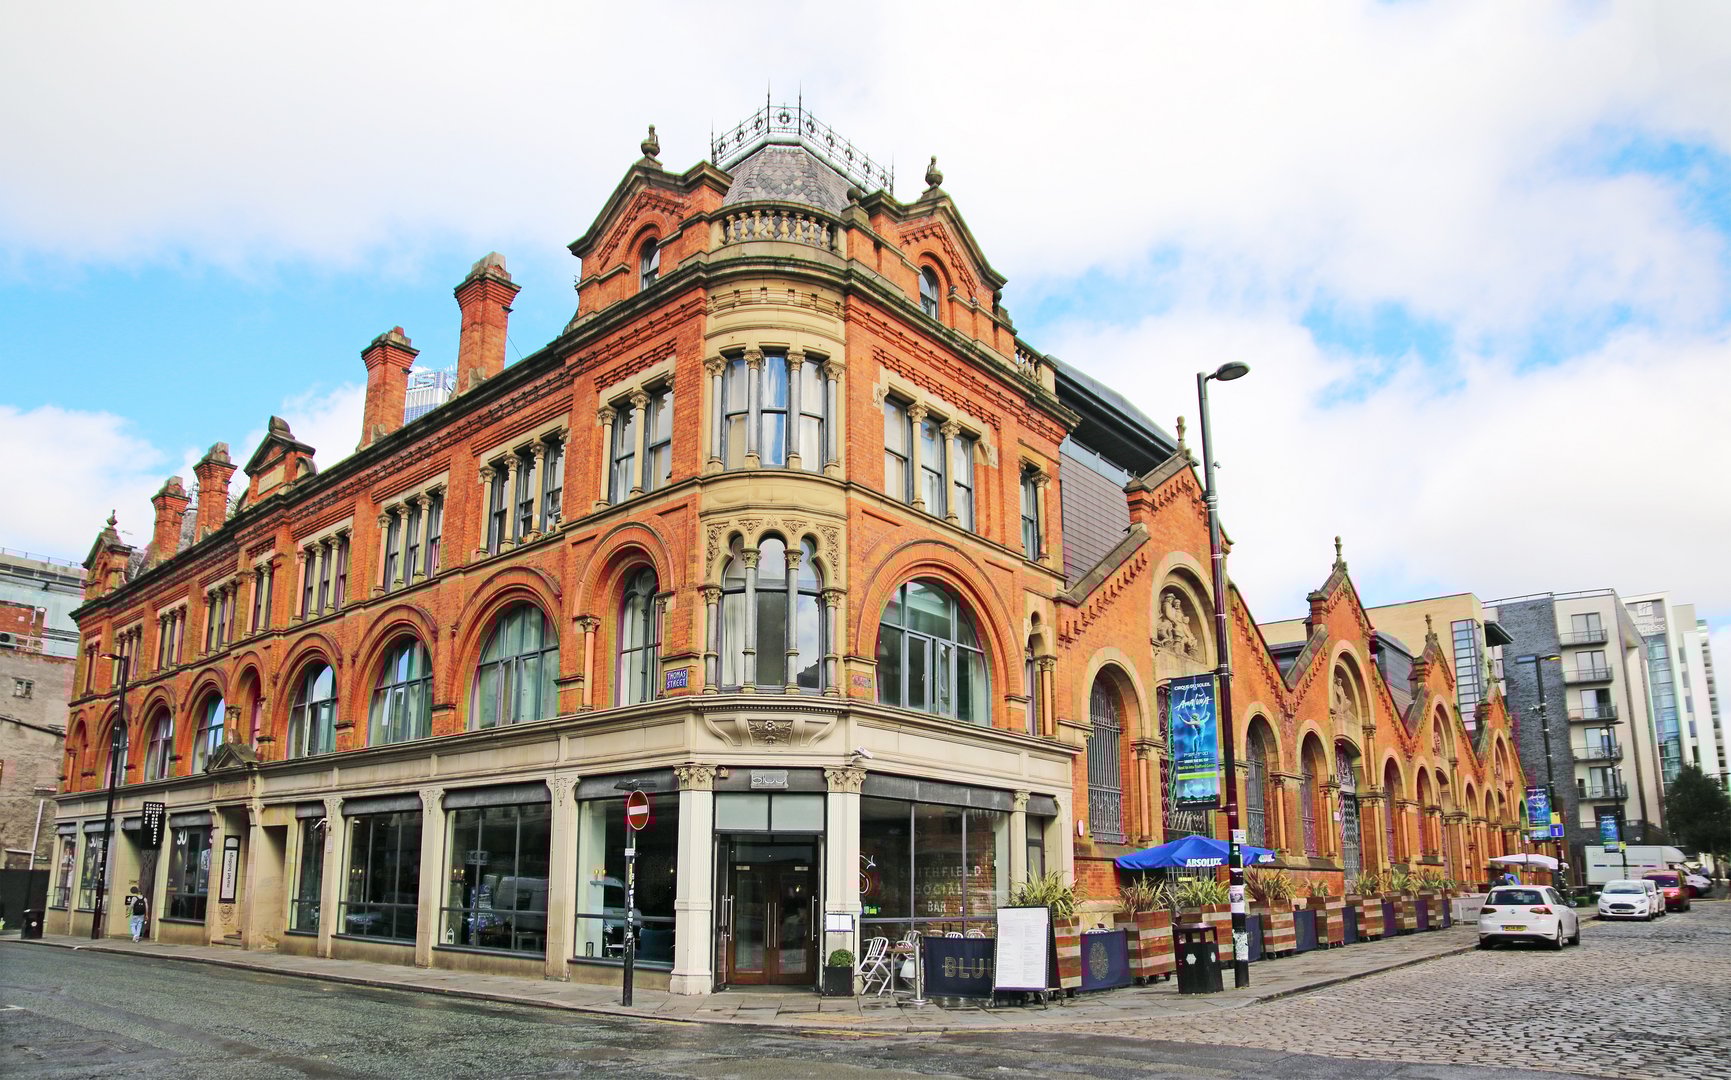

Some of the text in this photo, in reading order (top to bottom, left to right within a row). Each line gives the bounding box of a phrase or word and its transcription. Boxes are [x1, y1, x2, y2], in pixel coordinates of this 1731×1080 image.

[667, 670, 686, 680] THOMAS
[667, 679, 686, 689] STREET
[915, 883, 963, 895] SOCIAL
[928, 901, 947, 913] BAR
